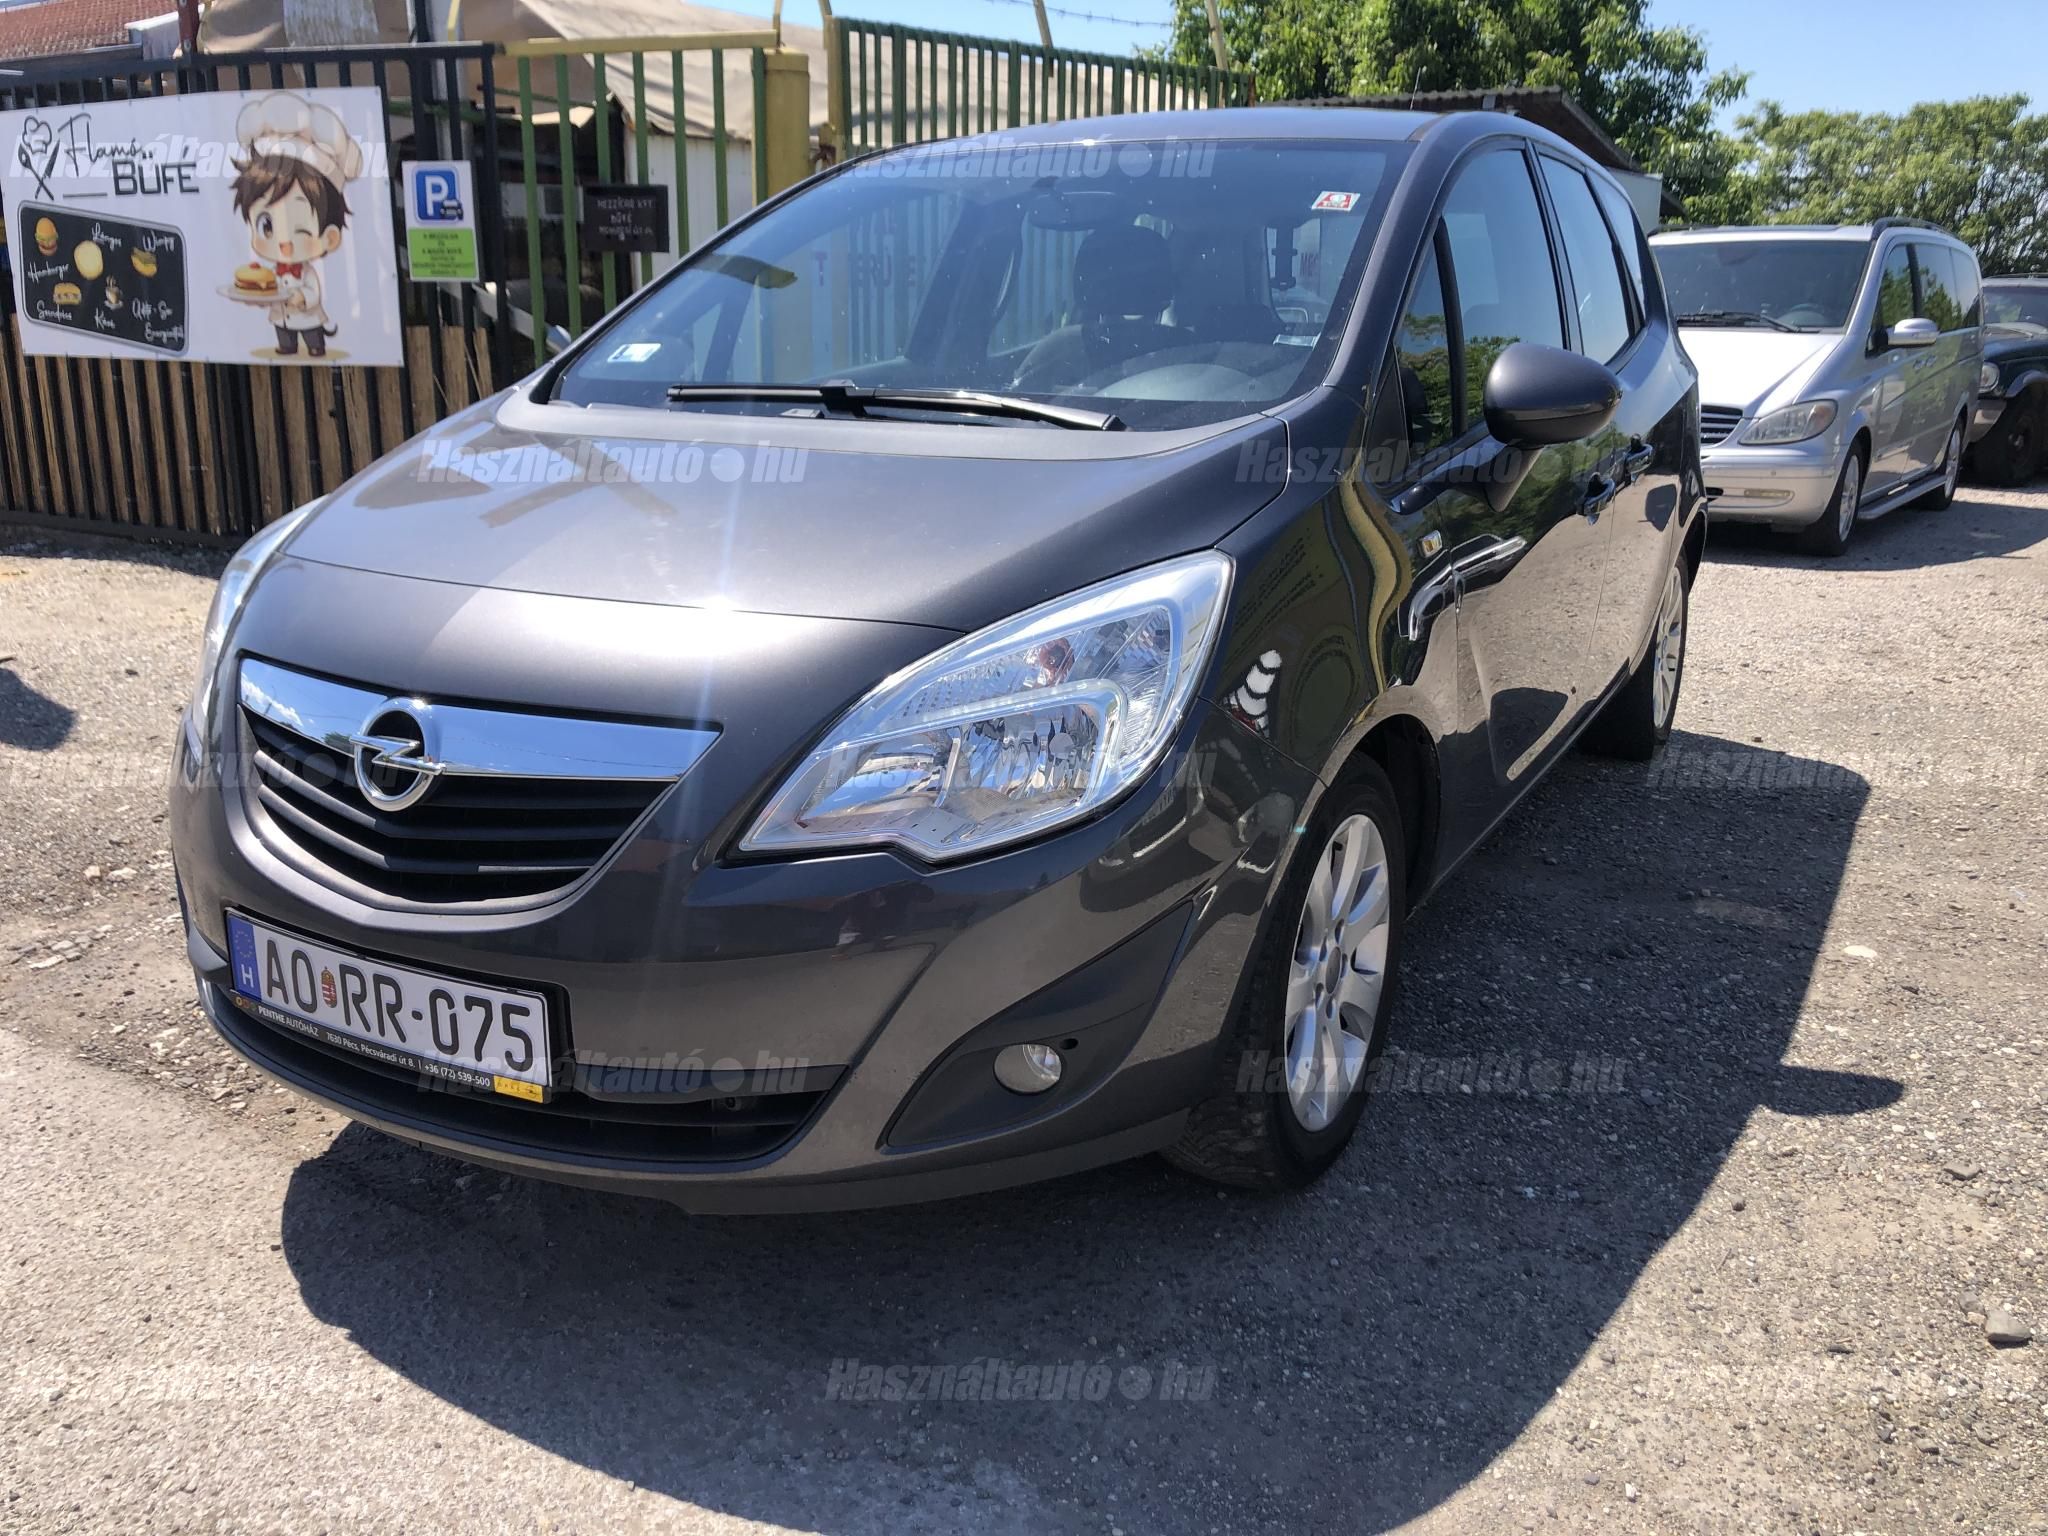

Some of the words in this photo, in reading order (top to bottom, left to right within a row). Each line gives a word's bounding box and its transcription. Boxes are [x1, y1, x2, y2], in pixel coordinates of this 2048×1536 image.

[112, 146, 199, 195] BÜFÉ
[424, 175, 449, 216] P
[241, 963, 255, 988] H
[285, 1017, 320, 1037] AUTÓHÁZ
[326, 1031, 342, 1045] 7630
[360, 1043, 398, 1061] Pécsváradi
[424, 1063, 439, 1075] +36
[440, 1066, 456, 1080] (72)
[457, 1070, 491, 1087] 539-500
